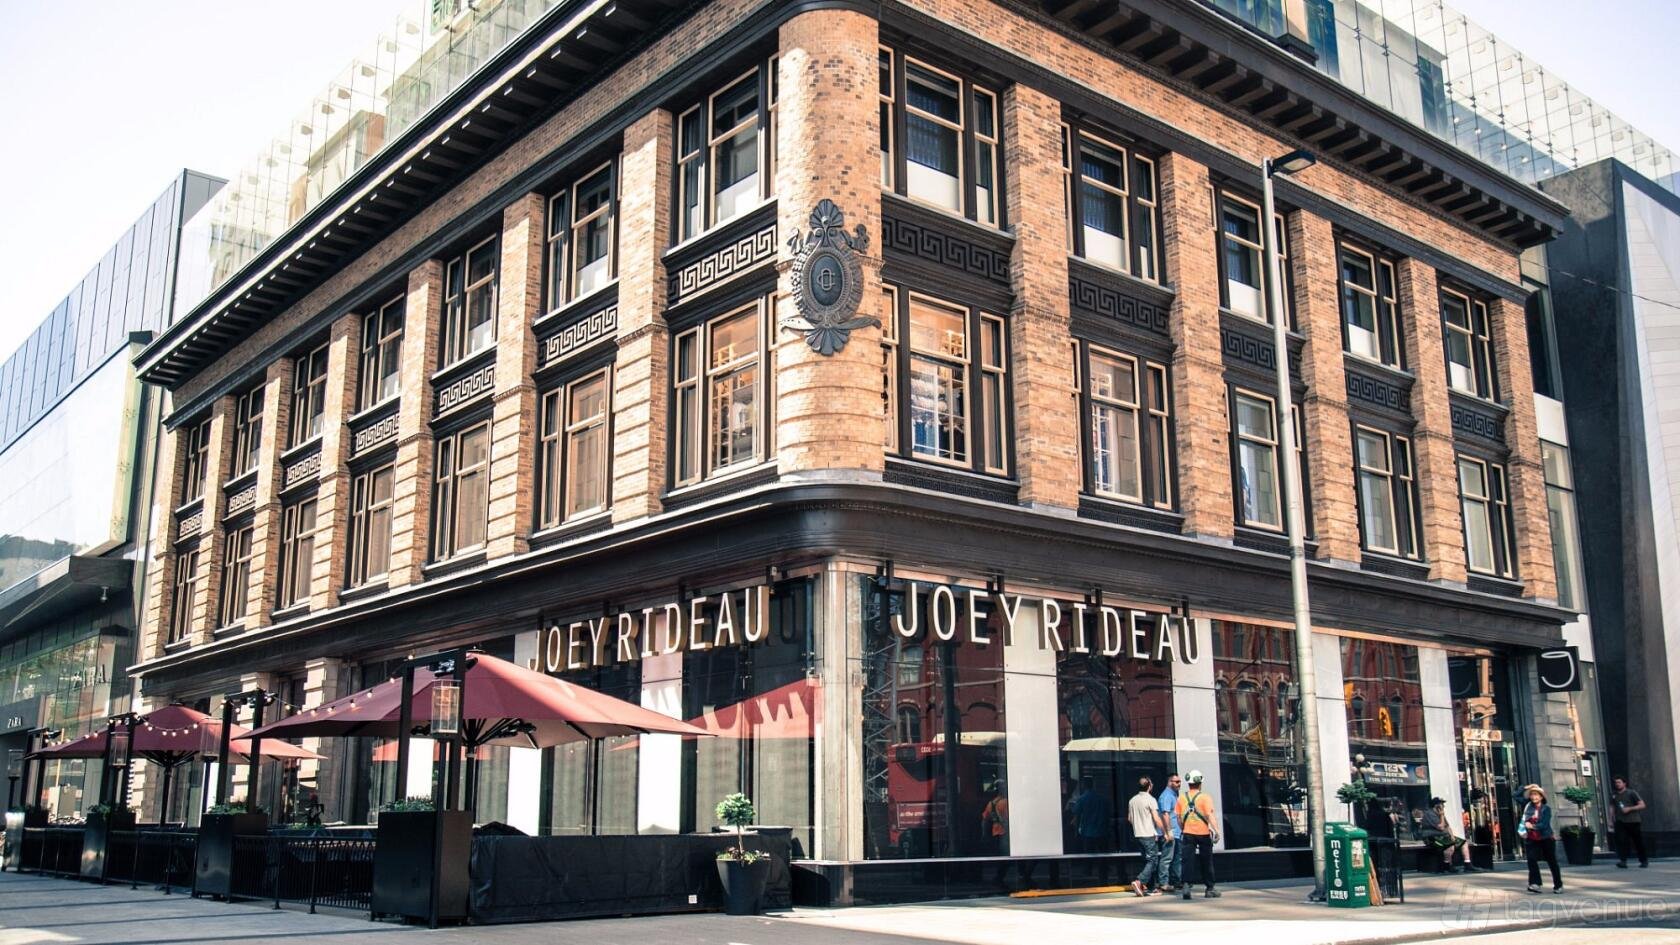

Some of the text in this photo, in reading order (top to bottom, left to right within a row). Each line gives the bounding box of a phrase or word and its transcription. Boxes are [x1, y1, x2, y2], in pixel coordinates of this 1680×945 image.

[528, 585, 768, 673] JOEY RIDEAU
[892, 582, 1200, 665] JOEY RIDEAU
[7, 717, 22, 729] ZARA
[1330, 839, 1343, 888] metro
